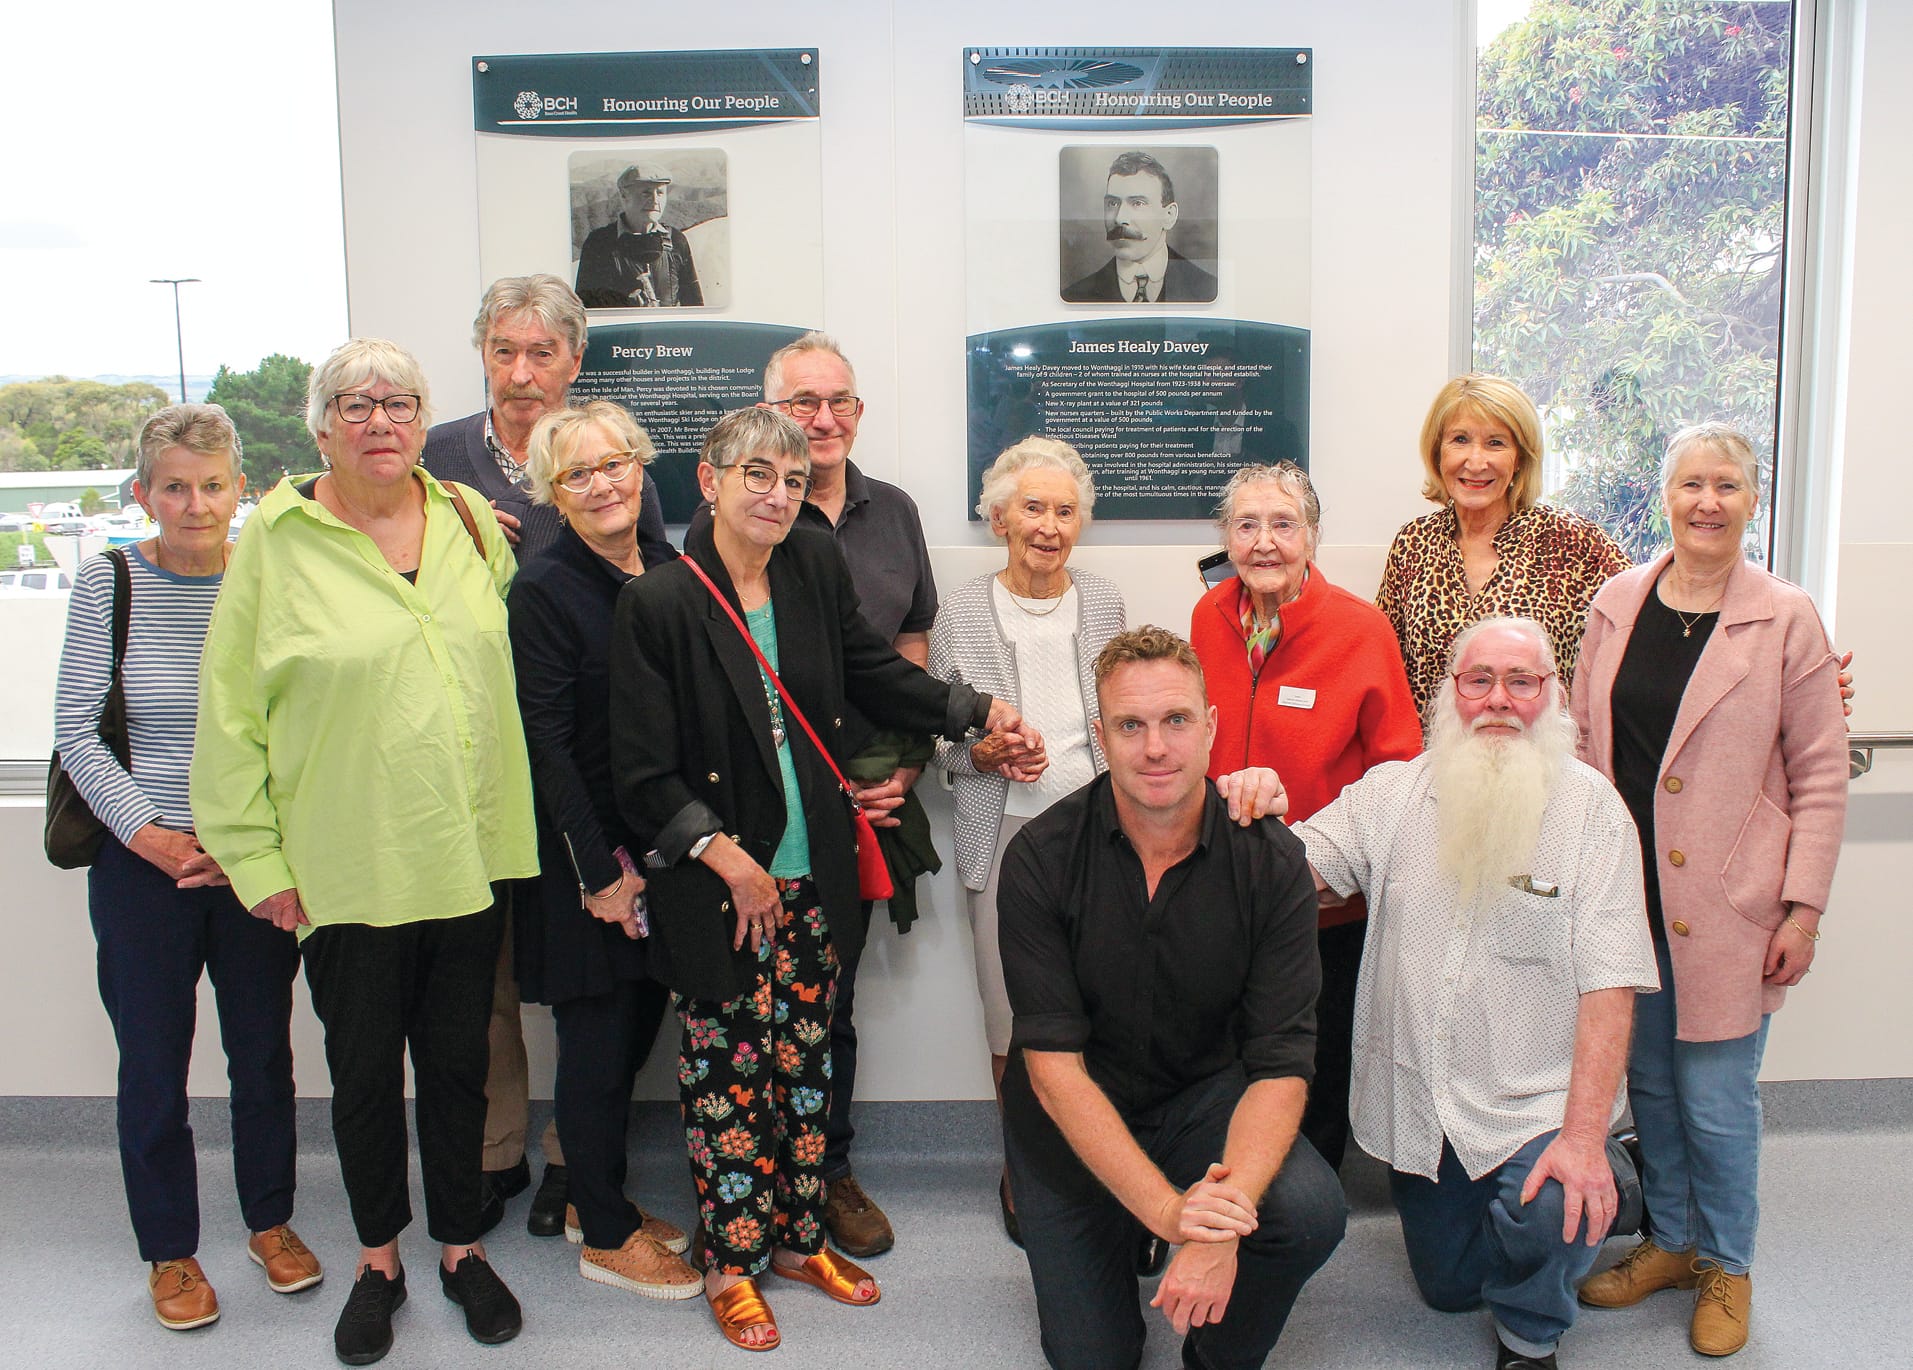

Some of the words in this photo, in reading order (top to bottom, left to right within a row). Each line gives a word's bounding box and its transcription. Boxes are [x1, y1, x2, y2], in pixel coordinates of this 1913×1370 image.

[1034, 90, 1069, 103] BCH
[1096, 93, 1181, 107] Honouring
[1184, 93, 1214, 106] Our
[1218, 93, 1272, 107] People
[544, 97, 577, 110] BCH
[603, 95, 688, 112] Honouring
[692, 96, 721, 109] Our
[725, 95, 779, 110] People
[612, 346, 653, 359] Percy
[656, 345, 693, 357] Brew
[1069, 341, 1115, 353] James
[1118, 341, 1160, 354] Healy
[1164, 341, 1209, 354] Davey
